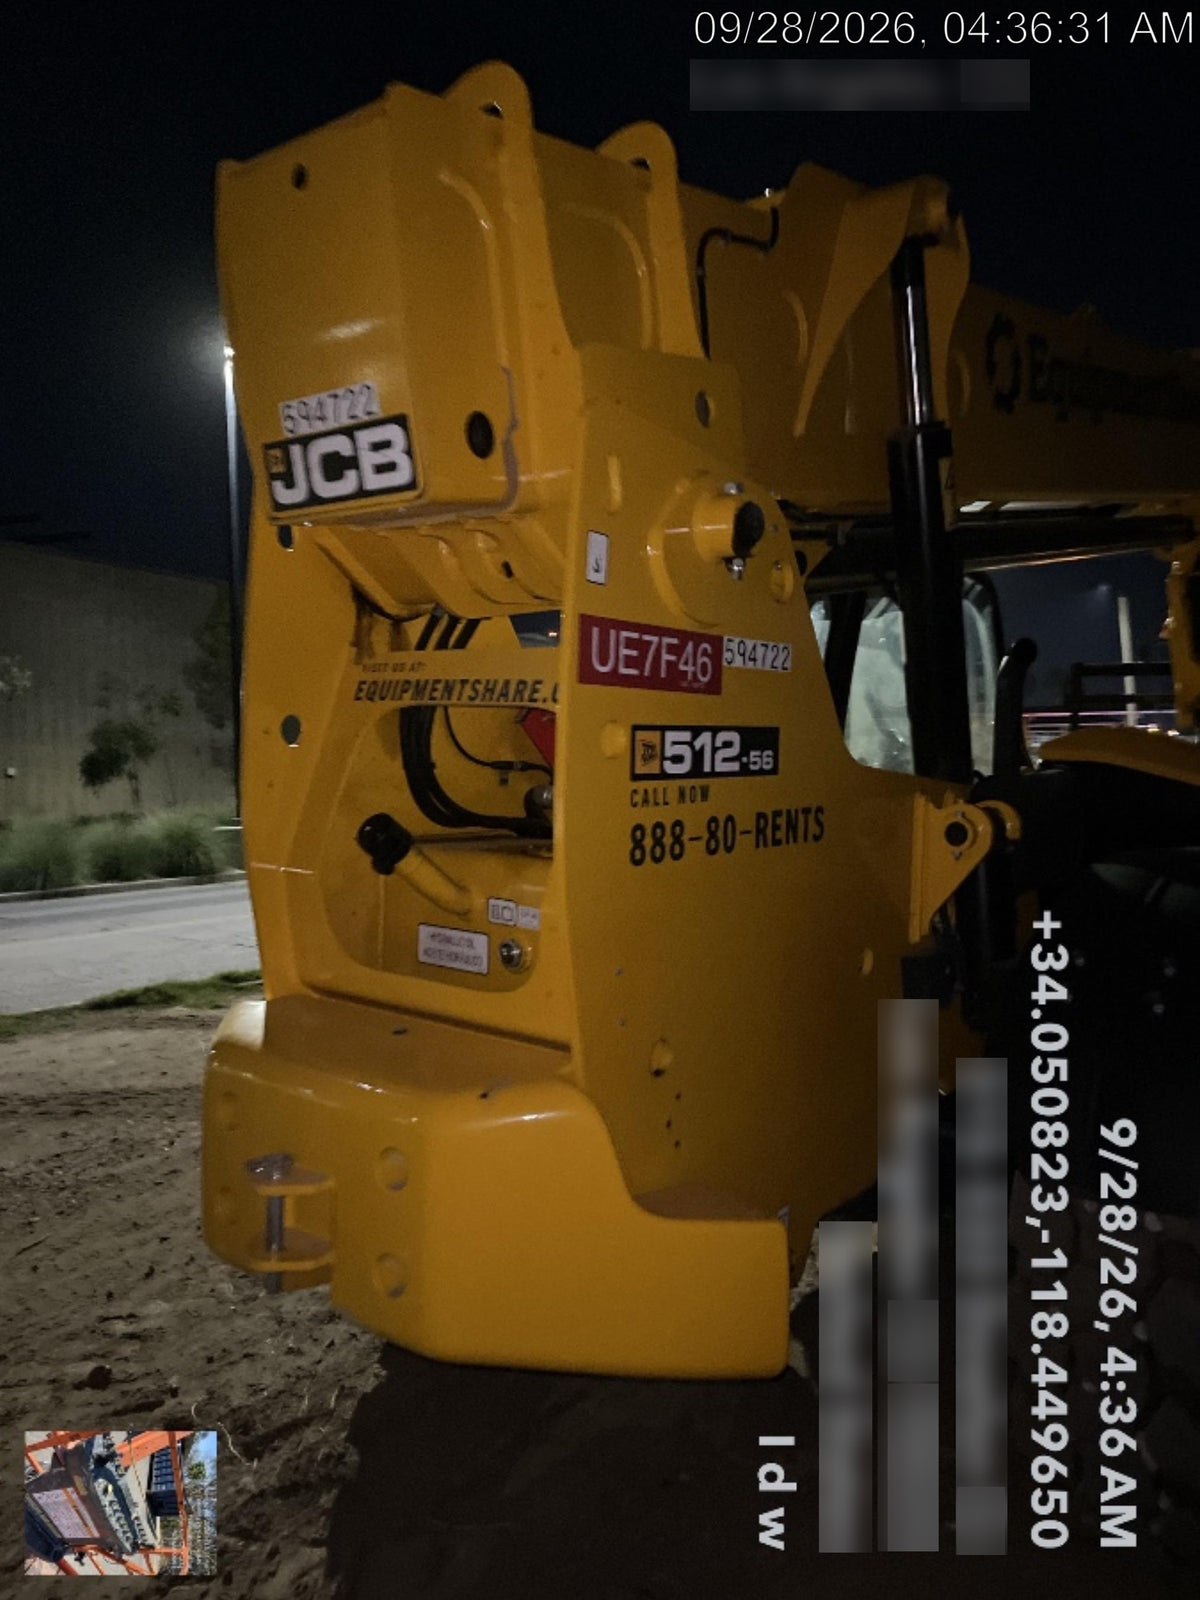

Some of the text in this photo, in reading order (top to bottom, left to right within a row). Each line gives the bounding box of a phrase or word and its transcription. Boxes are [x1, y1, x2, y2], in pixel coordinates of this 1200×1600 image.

[282, 383, 376, 433] 594722
[271, 422, 414, 506] JCB
[590, 626, 713, 683] UE7F46
[724, 638, 791, 671] 594722
[630, 785, 710, 808] CALL NOW
[629, 806, 825, 866] 888-80-RENTS
